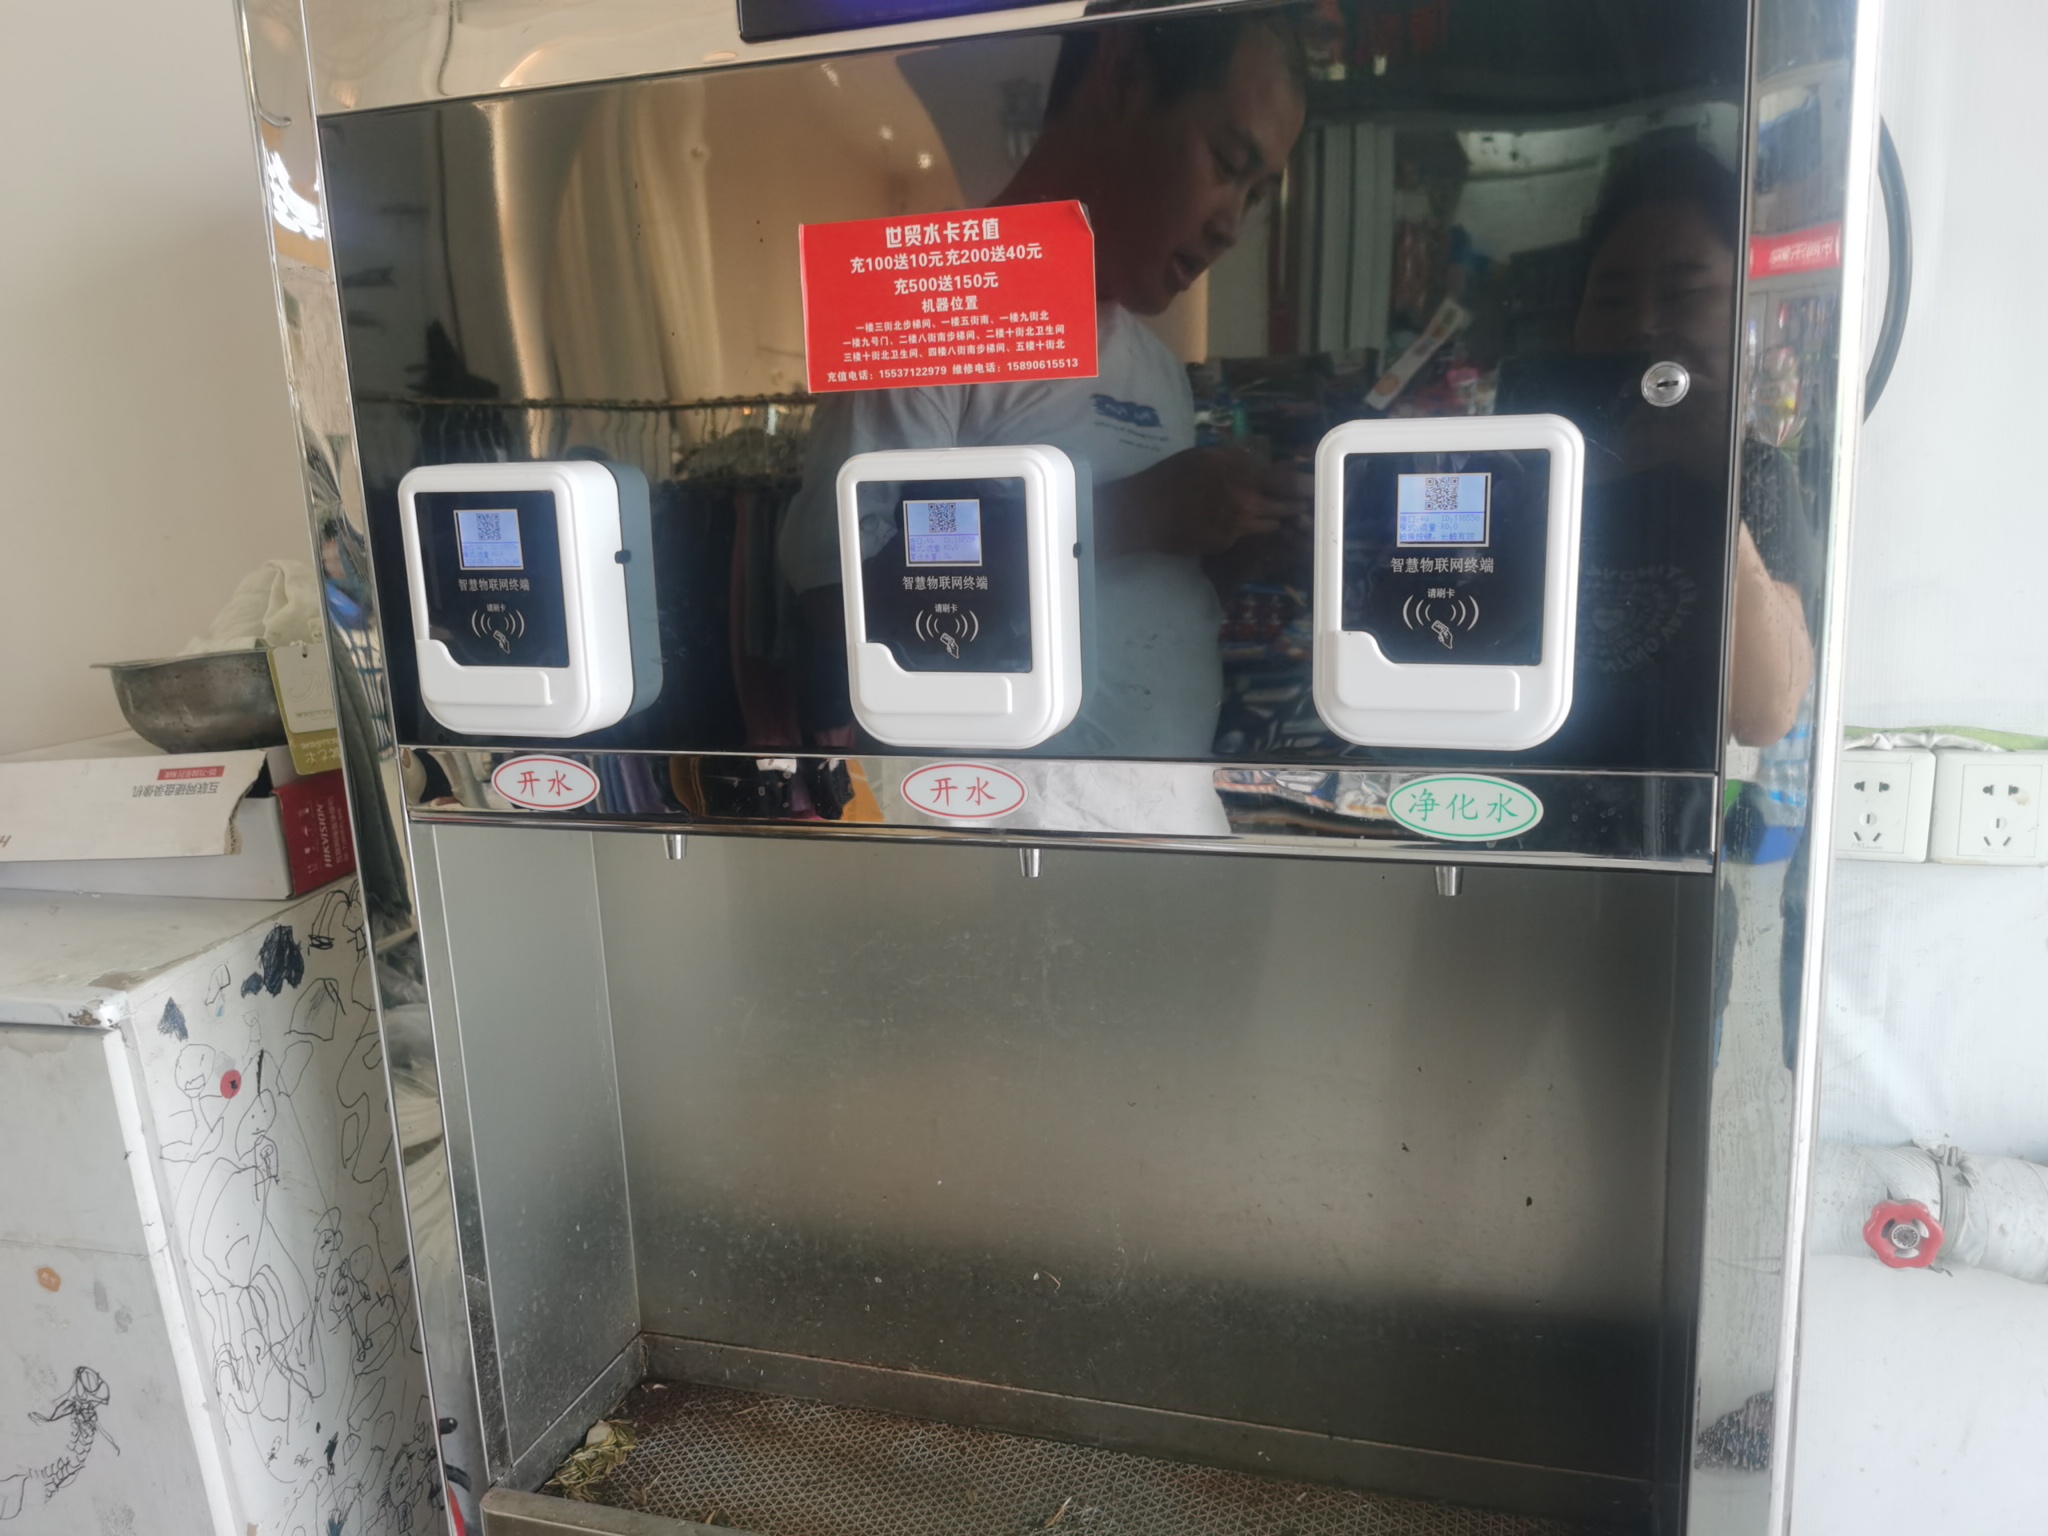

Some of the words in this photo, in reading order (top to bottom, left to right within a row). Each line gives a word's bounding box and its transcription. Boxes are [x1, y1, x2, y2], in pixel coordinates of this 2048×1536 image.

[885, 218, 1000, 248] 世贸水卡充值
[894, 271, 999, 295] 充500送150元
[921, 295, 979, 313] 机器位置
[1390, 557, 1495, 573] 智慧物联网终端
[457, 578, 530, 591] 智慧物联网终端
[902, 575, 988, 590] 智慧物联网终端
[1427, 587, 1456, 598] 请刷卡
[934, 603, 958, 613] 请刷卡
[517, 770, 573, 797] 开水
[930, 776, 997, 807] 开水
[1408, 787, 1519, 823] 净化水
[316, 804, 333, 868] HIKVISION
